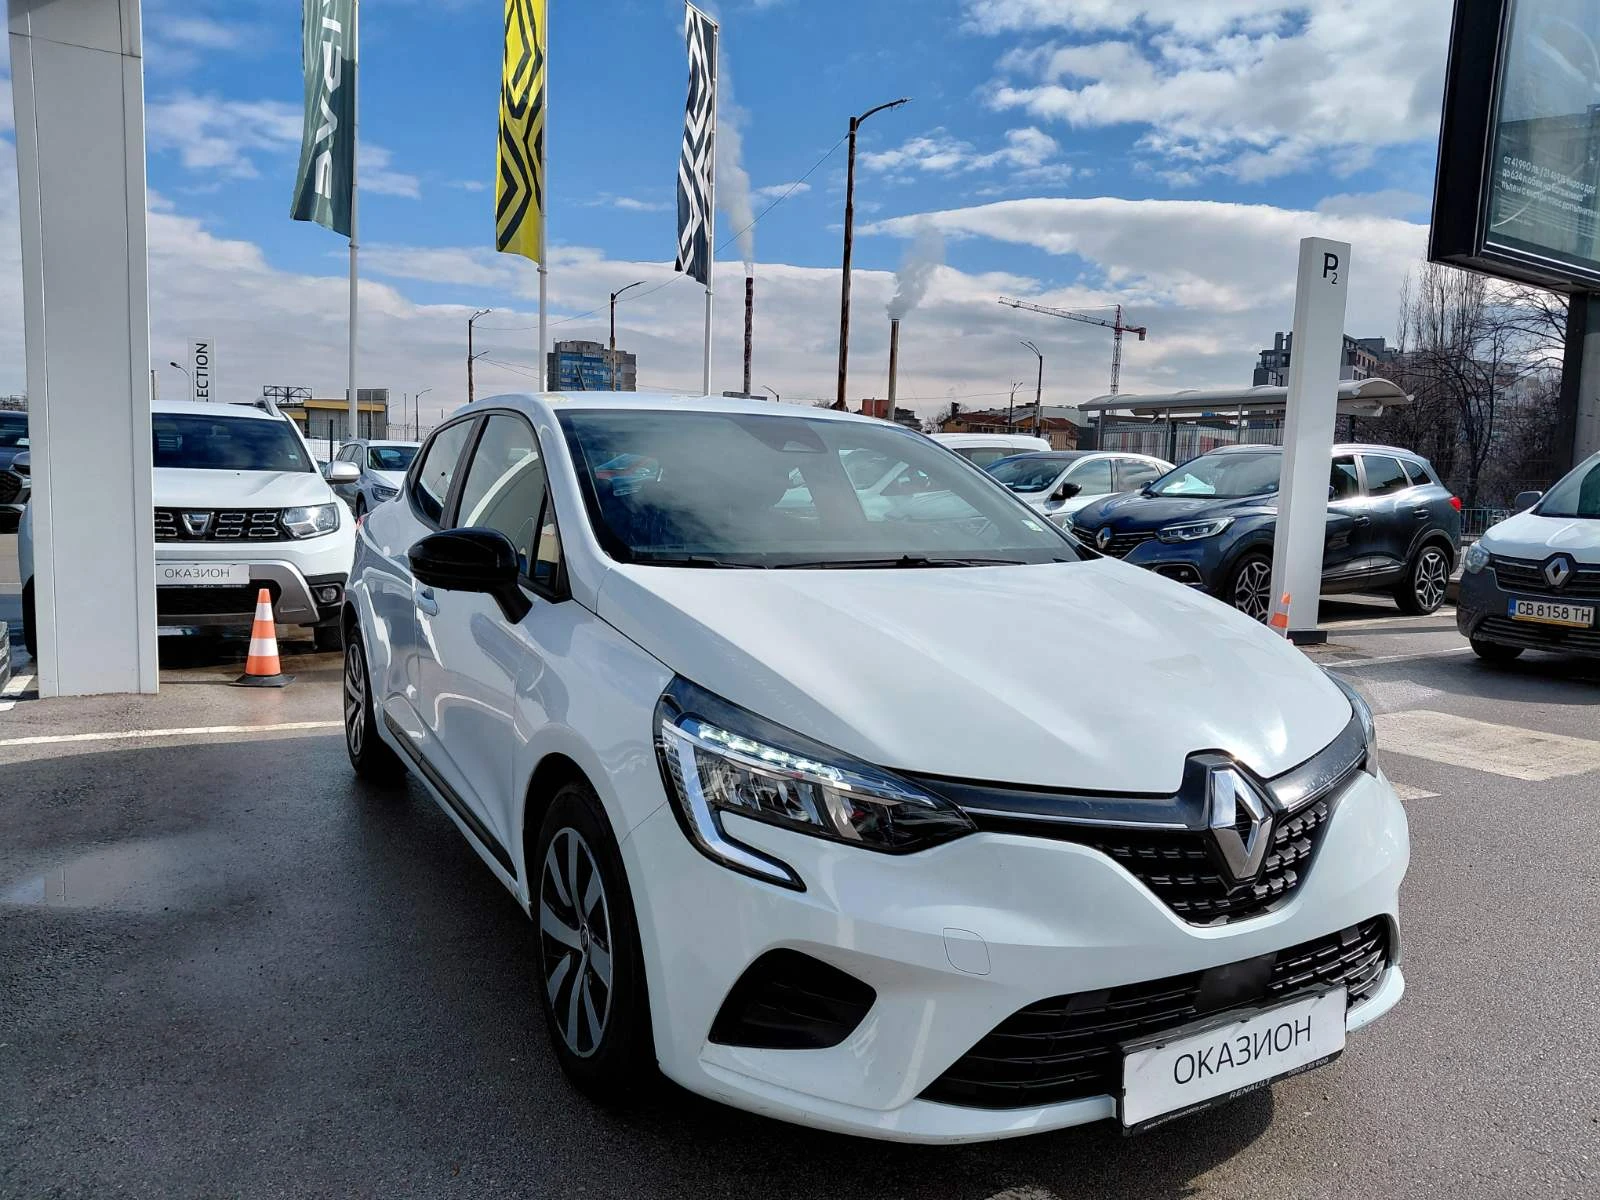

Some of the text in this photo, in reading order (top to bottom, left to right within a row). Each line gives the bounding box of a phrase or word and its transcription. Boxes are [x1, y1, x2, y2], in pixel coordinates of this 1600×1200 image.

[196, 343, 209, 402] ECTION
[164, 568, 230, 578] ОКАЗИОН
[1518, 602, 1534, 616] CB
[1537, 604, 1569, 619] 8158
[1573, 607, 1591, 621] TH
[1174, 1015, 1311, 1085] ОКАЗИОН
[1229, 1078, 1271, 1099] RENAULT
